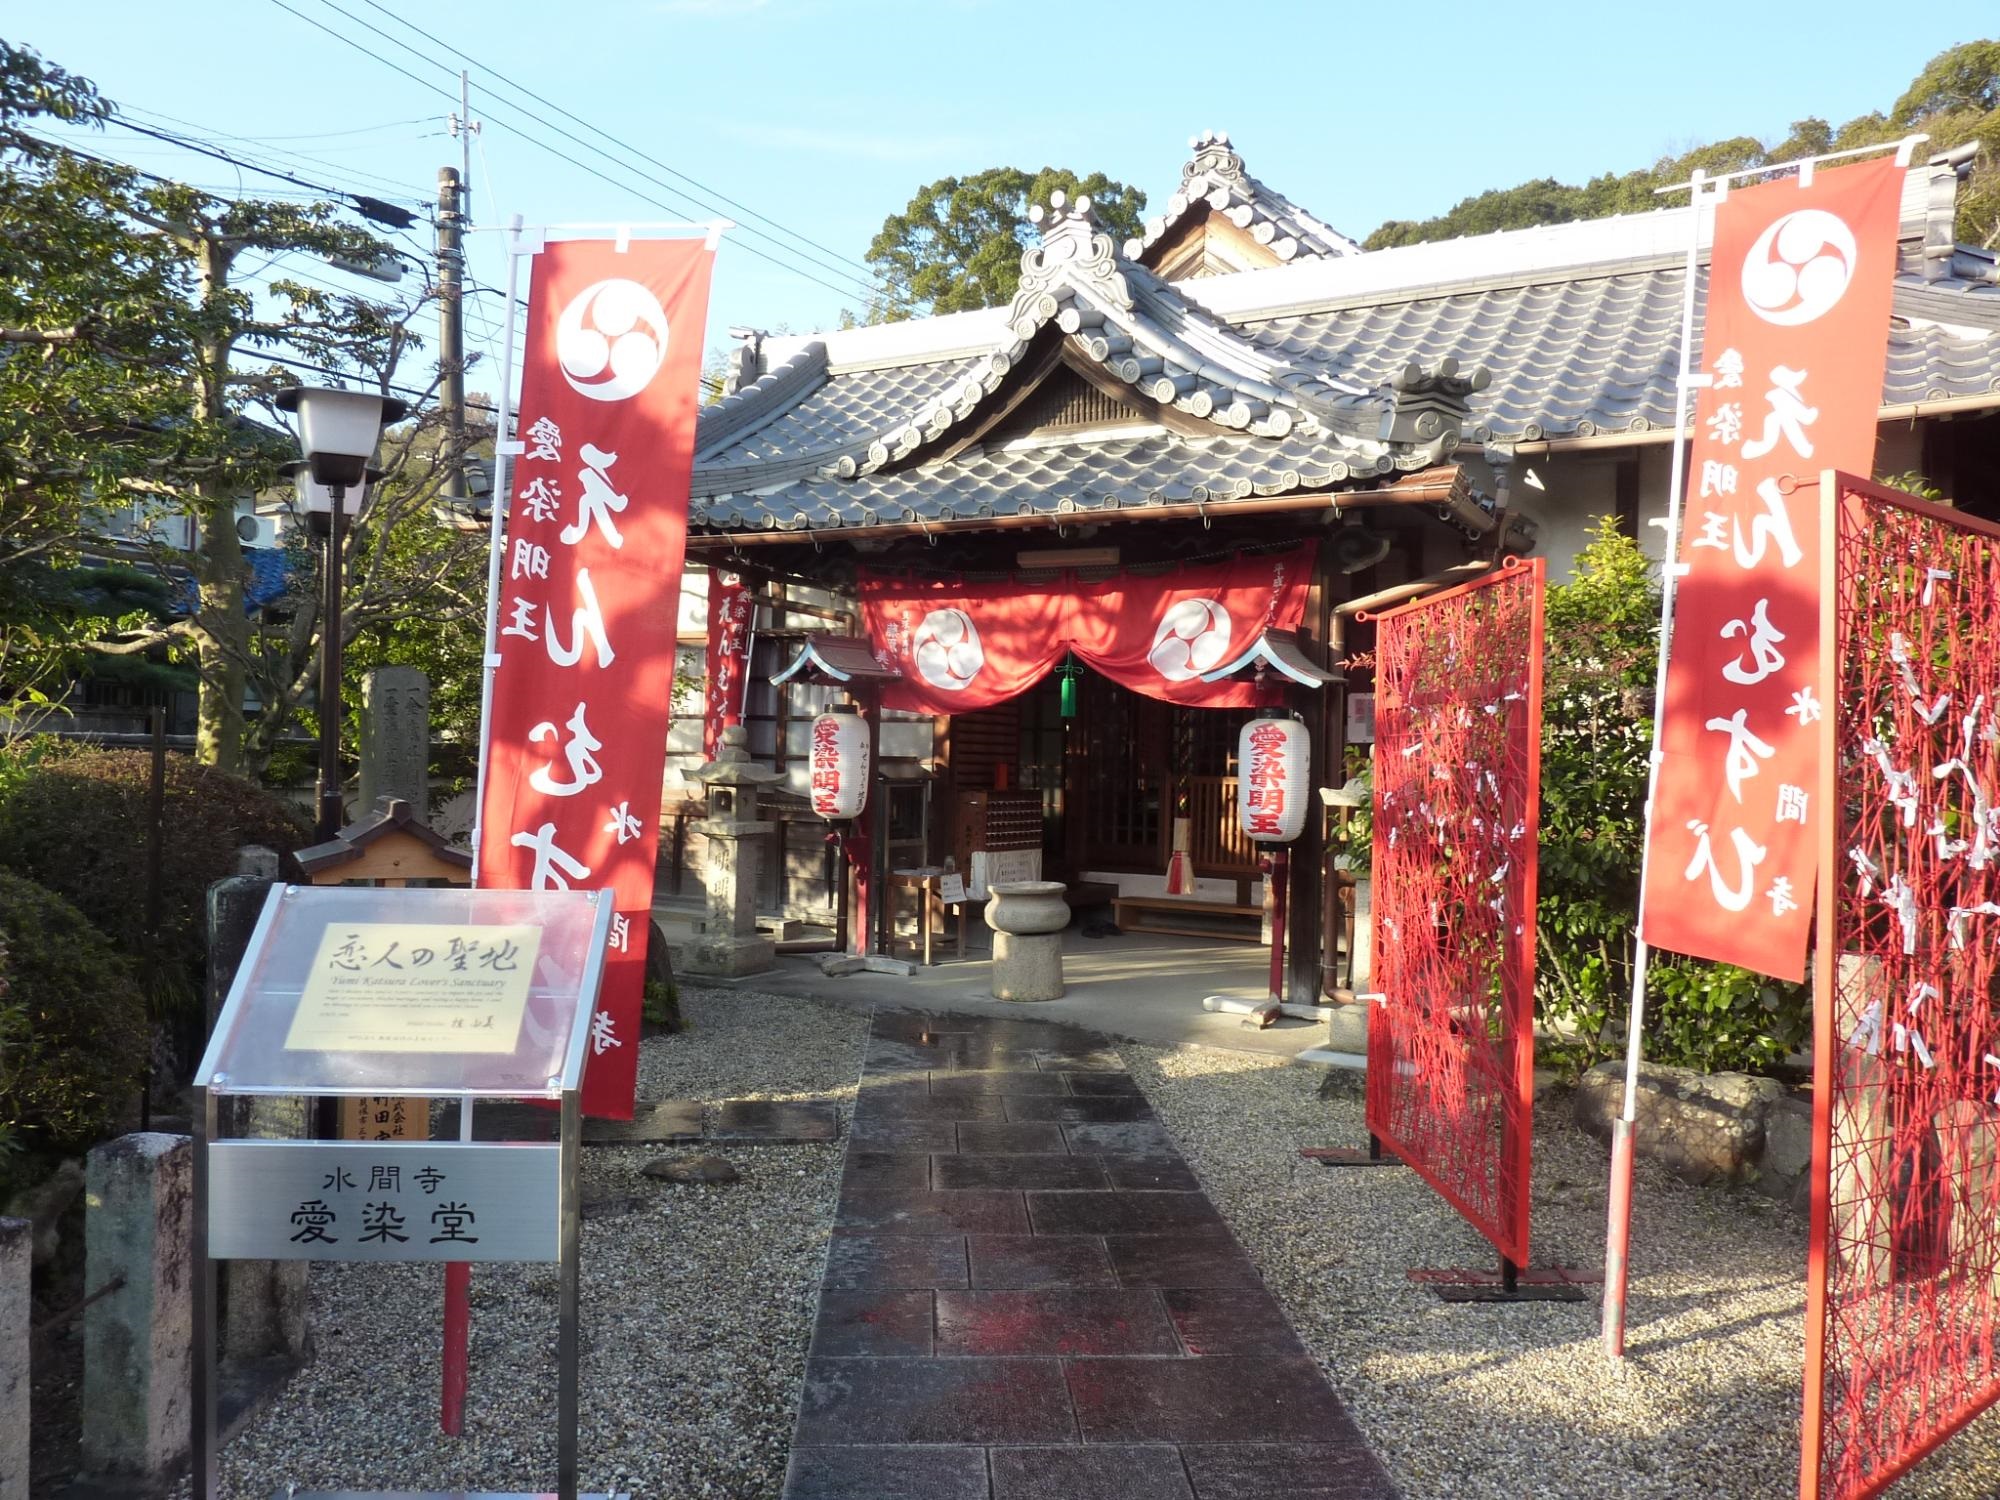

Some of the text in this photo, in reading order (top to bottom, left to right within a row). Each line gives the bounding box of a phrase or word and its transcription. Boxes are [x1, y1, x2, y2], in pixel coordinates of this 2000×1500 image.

[814, 717, 840, 815] 愛染明王
[1247, 722, 1287, 835] 愛染明王
[329, 934, 518, 971] 恋人の聖地
[322, 1166, 447, 1194] 水間寺
[290, 1200, 479, 1244] 愛染堂
